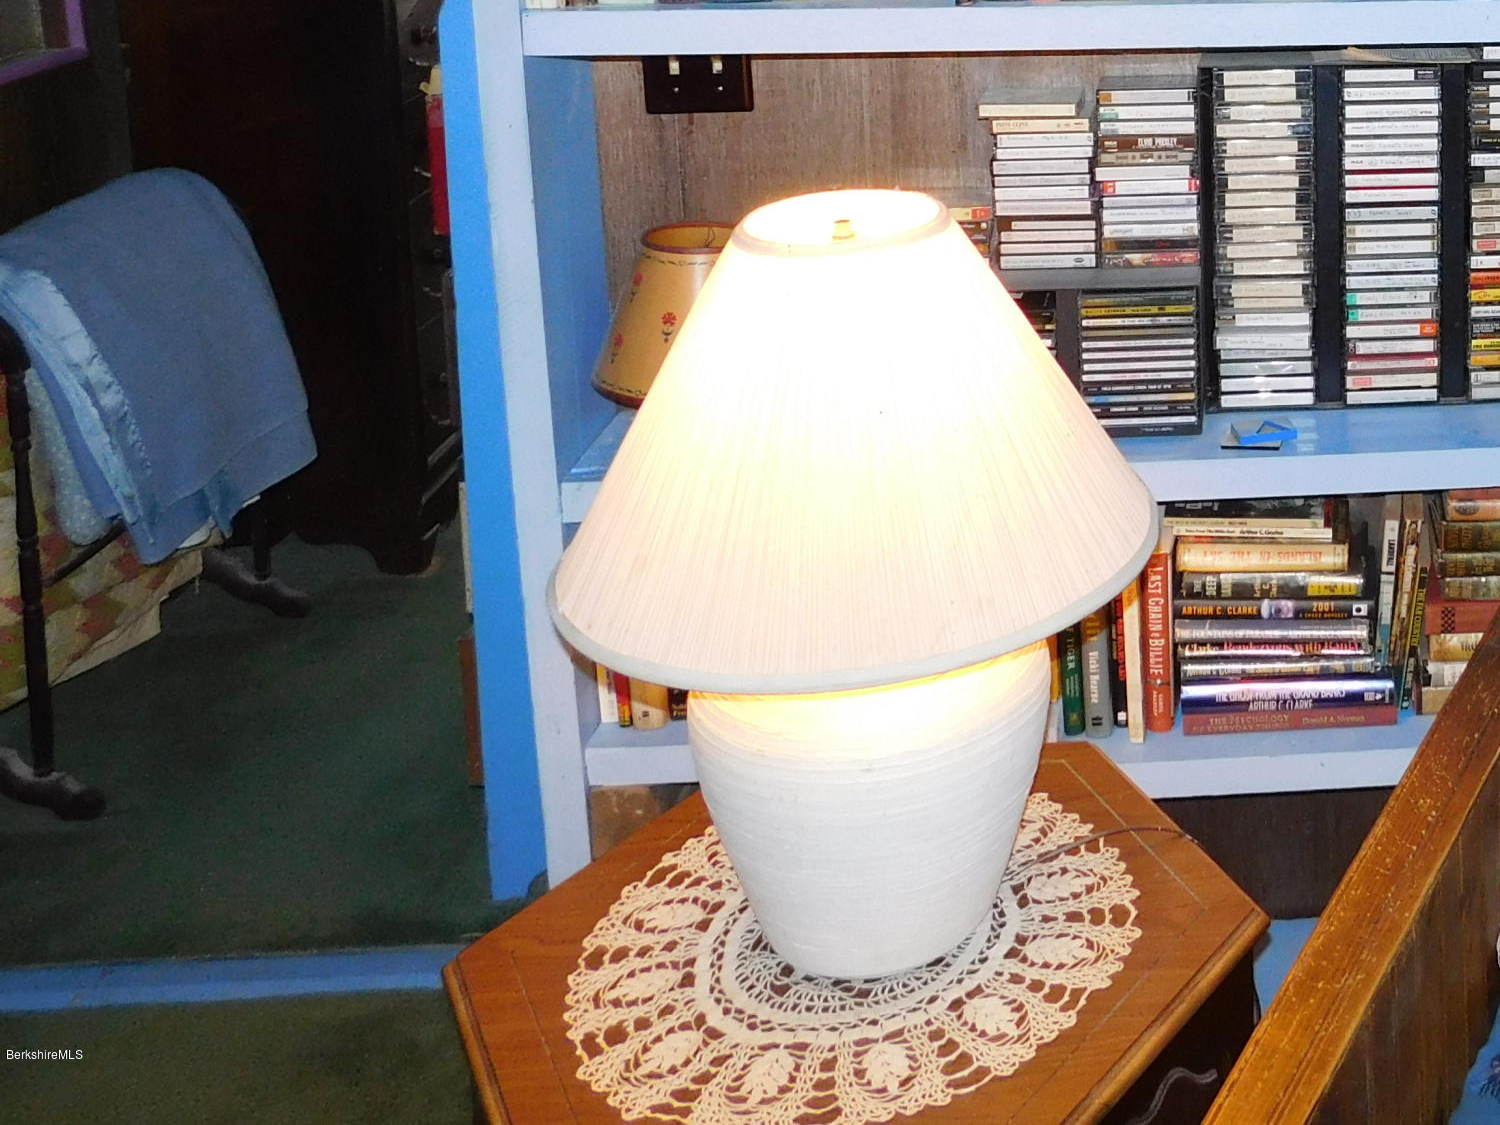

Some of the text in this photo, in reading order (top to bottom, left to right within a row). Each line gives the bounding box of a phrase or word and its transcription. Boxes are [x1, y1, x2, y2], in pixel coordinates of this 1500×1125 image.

[1418, 588, 1426, 602] THE
[1182, 606, 1213, 614] ARTHUR
[1227, 606, 1257, 614] CLARKE
[1312, 603, 1334, 612] 2001
[1416, 603, 1424, 615] FAR
[1148, 567, 1165, 675] LAST CHAIN BILLIE
[1066, 638, 1075, 670] TIGER
